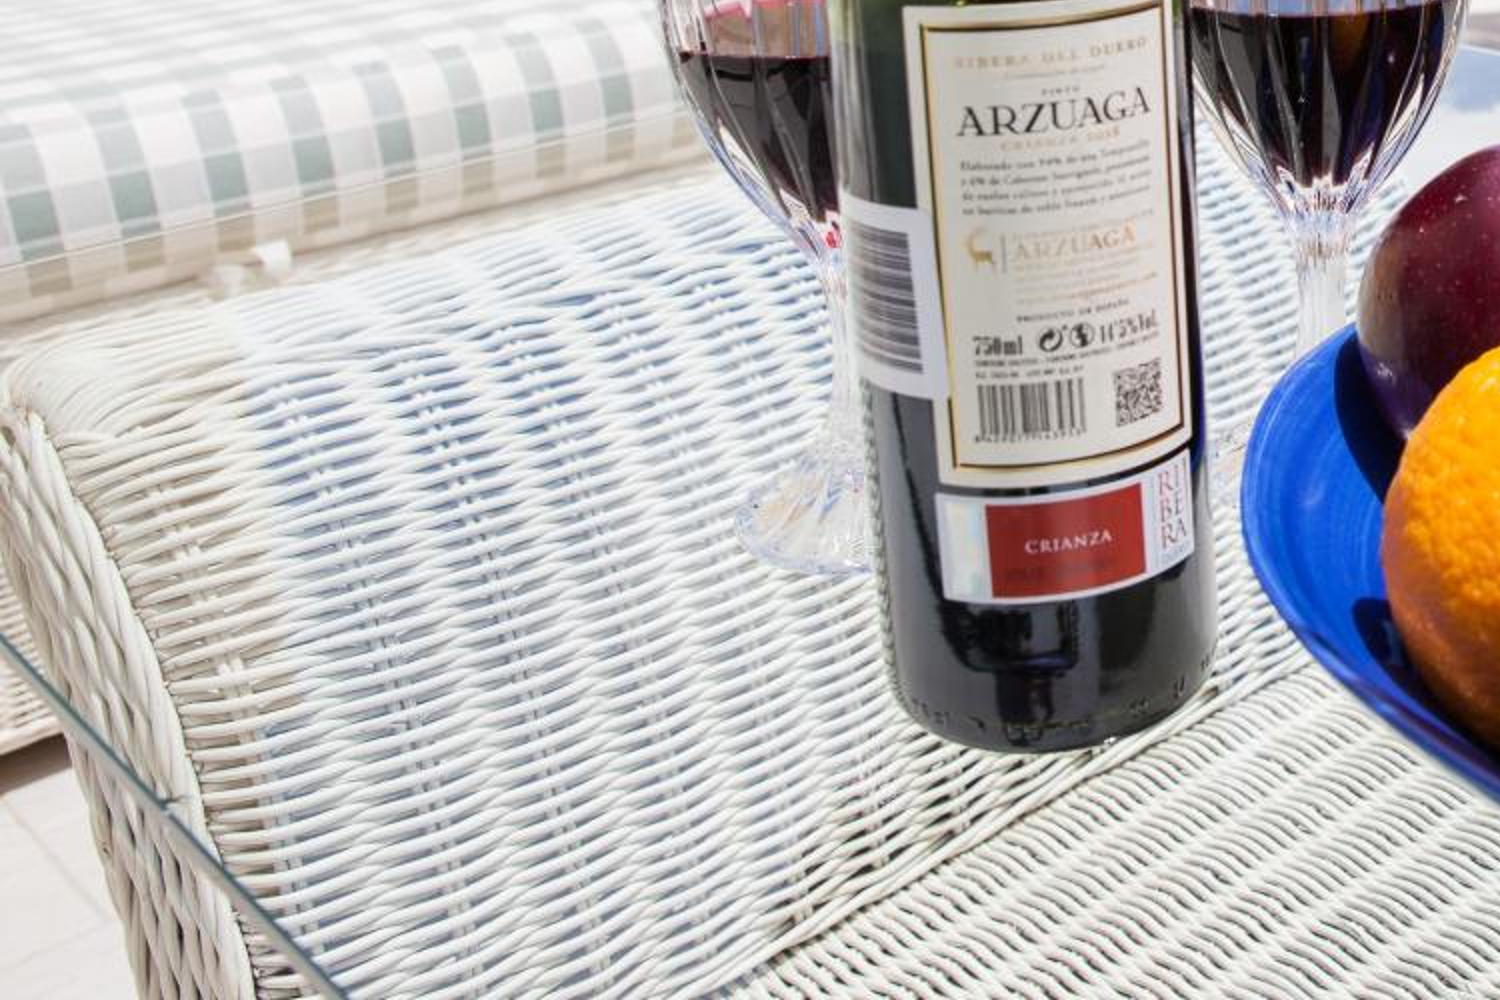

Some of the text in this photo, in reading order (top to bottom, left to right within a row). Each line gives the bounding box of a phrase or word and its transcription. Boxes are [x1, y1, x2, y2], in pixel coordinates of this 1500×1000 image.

[956, 86, 1152, 137] ARZUAGA
[1015, 226, 1136, 259] ARZUAGA
[1024, 530, 1113, 554] CRIANZA
